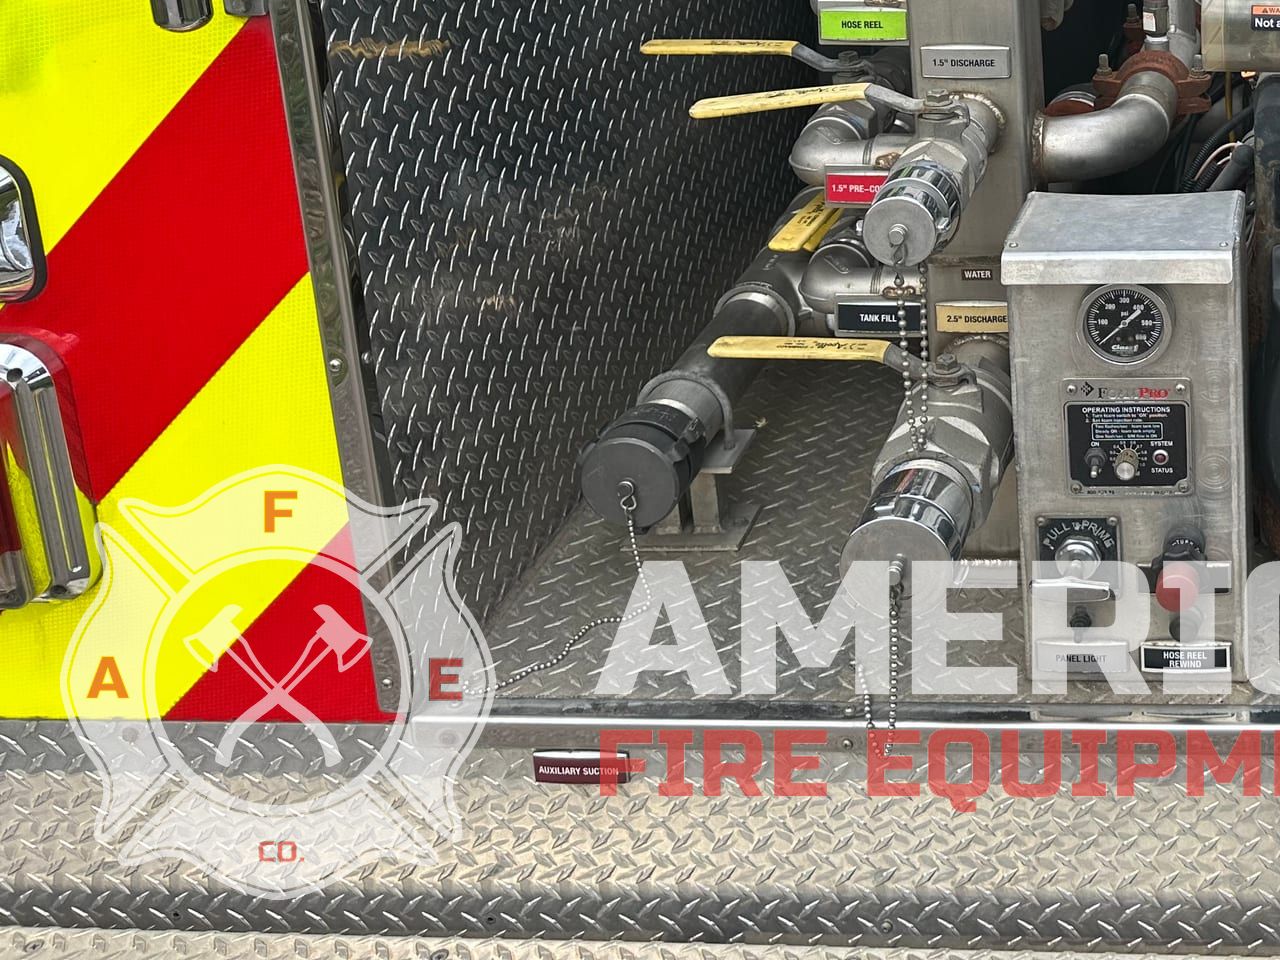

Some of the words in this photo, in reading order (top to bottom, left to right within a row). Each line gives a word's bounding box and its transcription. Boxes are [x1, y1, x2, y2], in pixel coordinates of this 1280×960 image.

[841, 20, 862, 29] HOSE
[864, 20, 883, 29] REEL
[1254, 17, 1274, 28] Not
[933, 58, 949, 67] 1.5"
[950, 58, 996, 68] DISCHARGE
[831, 184, 848, 192] 1.5"
[964, 270, 992, 278] WATER
[860, 314, 880, 322] TANK
[881, 314, 897, 322] FILL
[946, 314, 962, 323] 2.5"
[964, 315, 1008, 323] DISCHARGE
[1042, 522, 1071, 550] PULL
[1081, 520, 1115, 548] PRIME
[1056, 654, 1082, 662] PANEL
[1084, 654, 1108, 662] LIGHT
[1163, 651, 1185, 660] HOSE
[1187, 652, 1208, 660] REEL
[1169, 660, 1202, 668] REWIND
[539, 766, 580, 776] AUXILIARY
[582, 767, 618, 776] SUCTION
